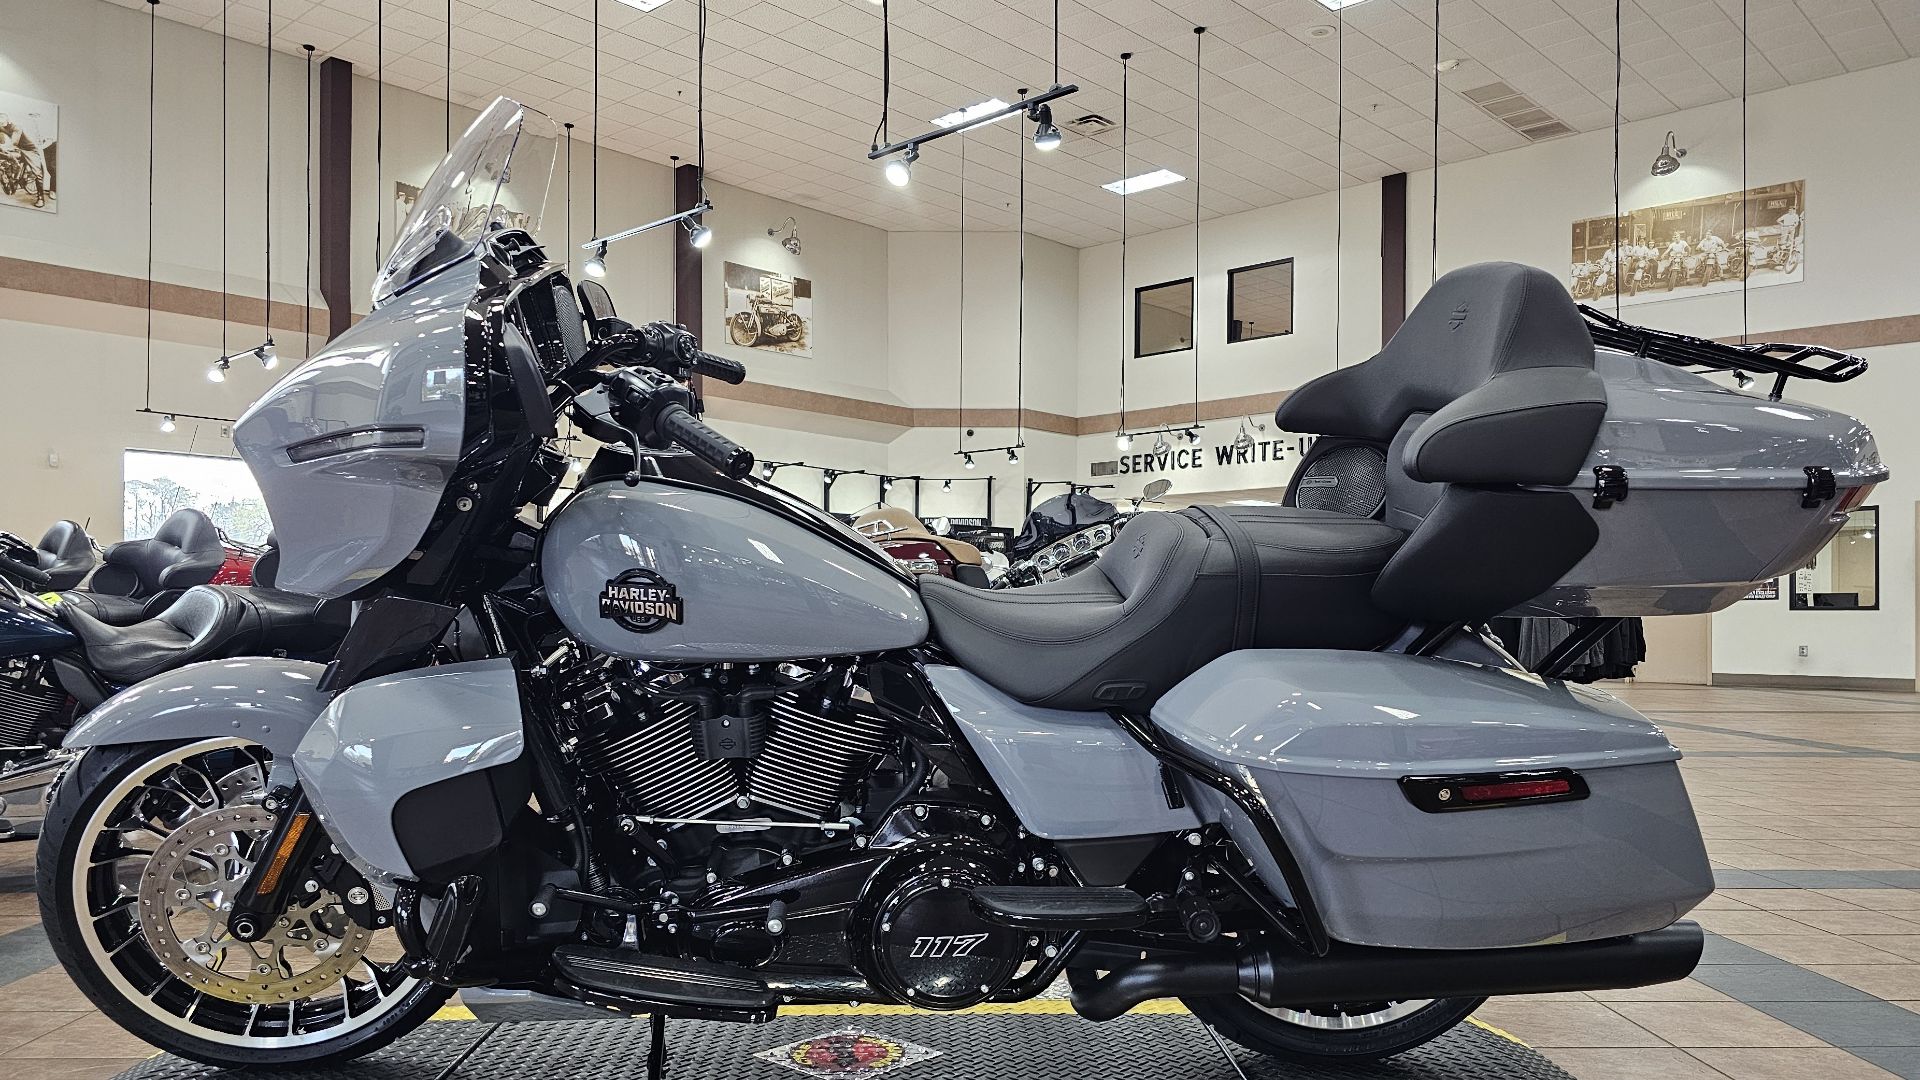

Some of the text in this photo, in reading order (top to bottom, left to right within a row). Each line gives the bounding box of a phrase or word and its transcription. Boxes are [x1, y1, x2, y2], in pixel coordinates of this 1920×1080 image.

[1119, 436, 1318, 474] SERVICE WRITE-U
[608, 585, 671, 602] HARLEY-
[601, 598, 677, 621] DAVIDSON
[909, 932, 989, 957] 117
